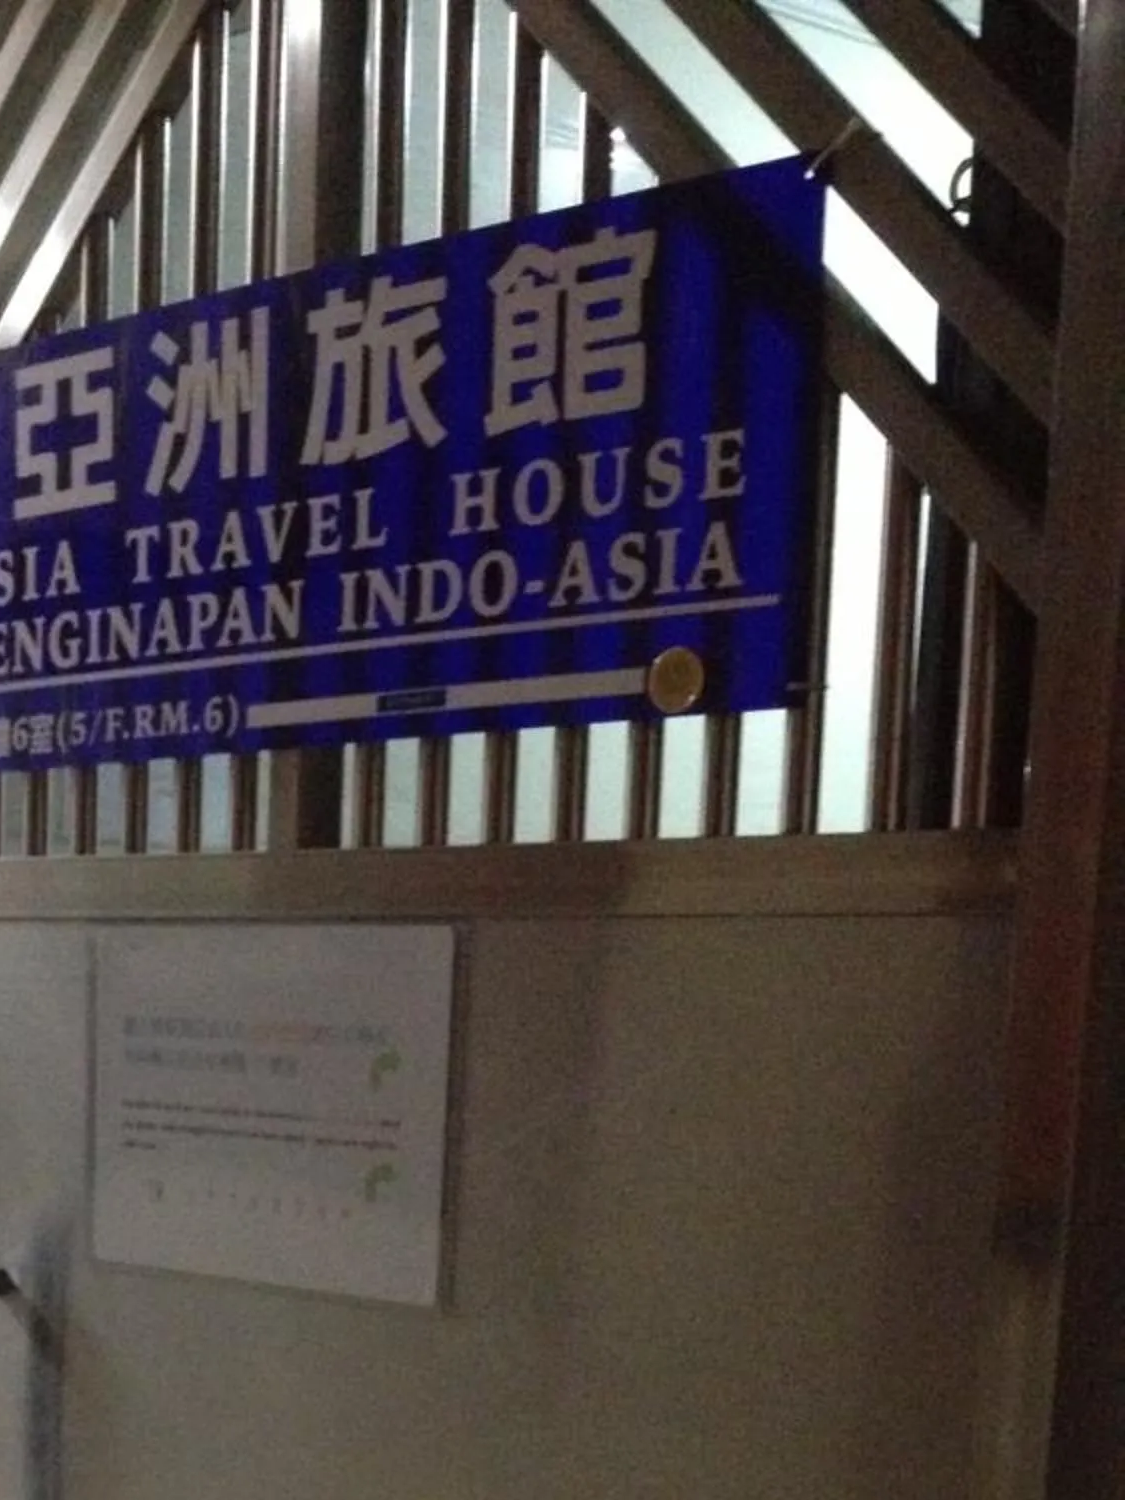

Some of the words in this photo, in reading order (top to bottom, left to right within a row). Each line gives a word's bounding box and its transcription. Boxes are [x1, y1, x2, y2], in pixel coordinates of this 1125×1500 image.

[13, 227, 659, 520] 亞洲旅館
[125, 487, 388, 584] TRAVEL
[449, 428, 747, 537] HOUSE
[337, 520, 743, 633] INDO-ASIA
